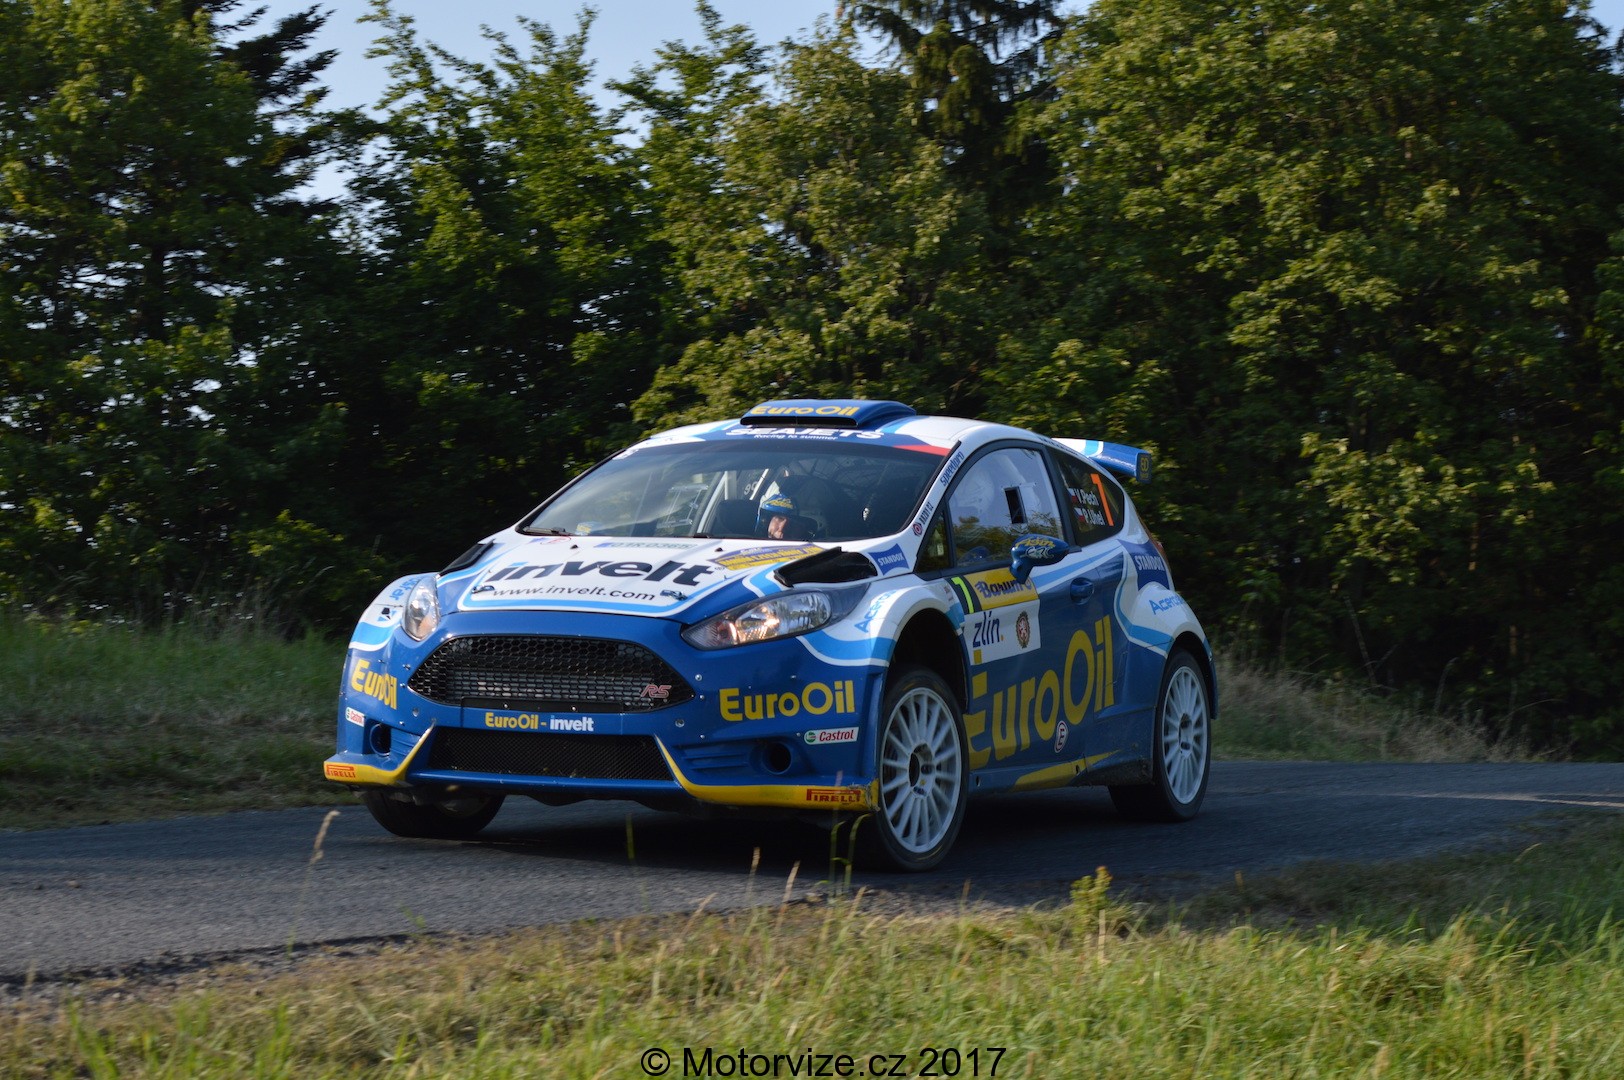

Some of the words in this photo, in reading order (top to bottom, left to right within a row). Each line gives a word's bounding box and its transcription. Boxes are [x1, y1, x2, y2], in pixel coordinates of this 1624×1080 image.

[750, 405, 860, 416] EuroOil
[1090, 473, 1115, 526] 1
[877, 552, 905, 566] STANDOX
[1134, 555, 1165, 572] STANDOX
[484, 560, 715, 587] invelt
[493, 585, 656, 601] www.invelt.com
[951, 576, 975, 614] 1
[719, 680, 856, 722] EuroOil
[962, 615, 1115, 771] EuroOil
[485, 712, 539, 729] EuroOil
[549, 714, 594, 732] invelt
[819, 730, 855, 742] Castrol
[325, 764, 356, 778] PIRELLI
[806, 788, 862, 802] PIRELLI
